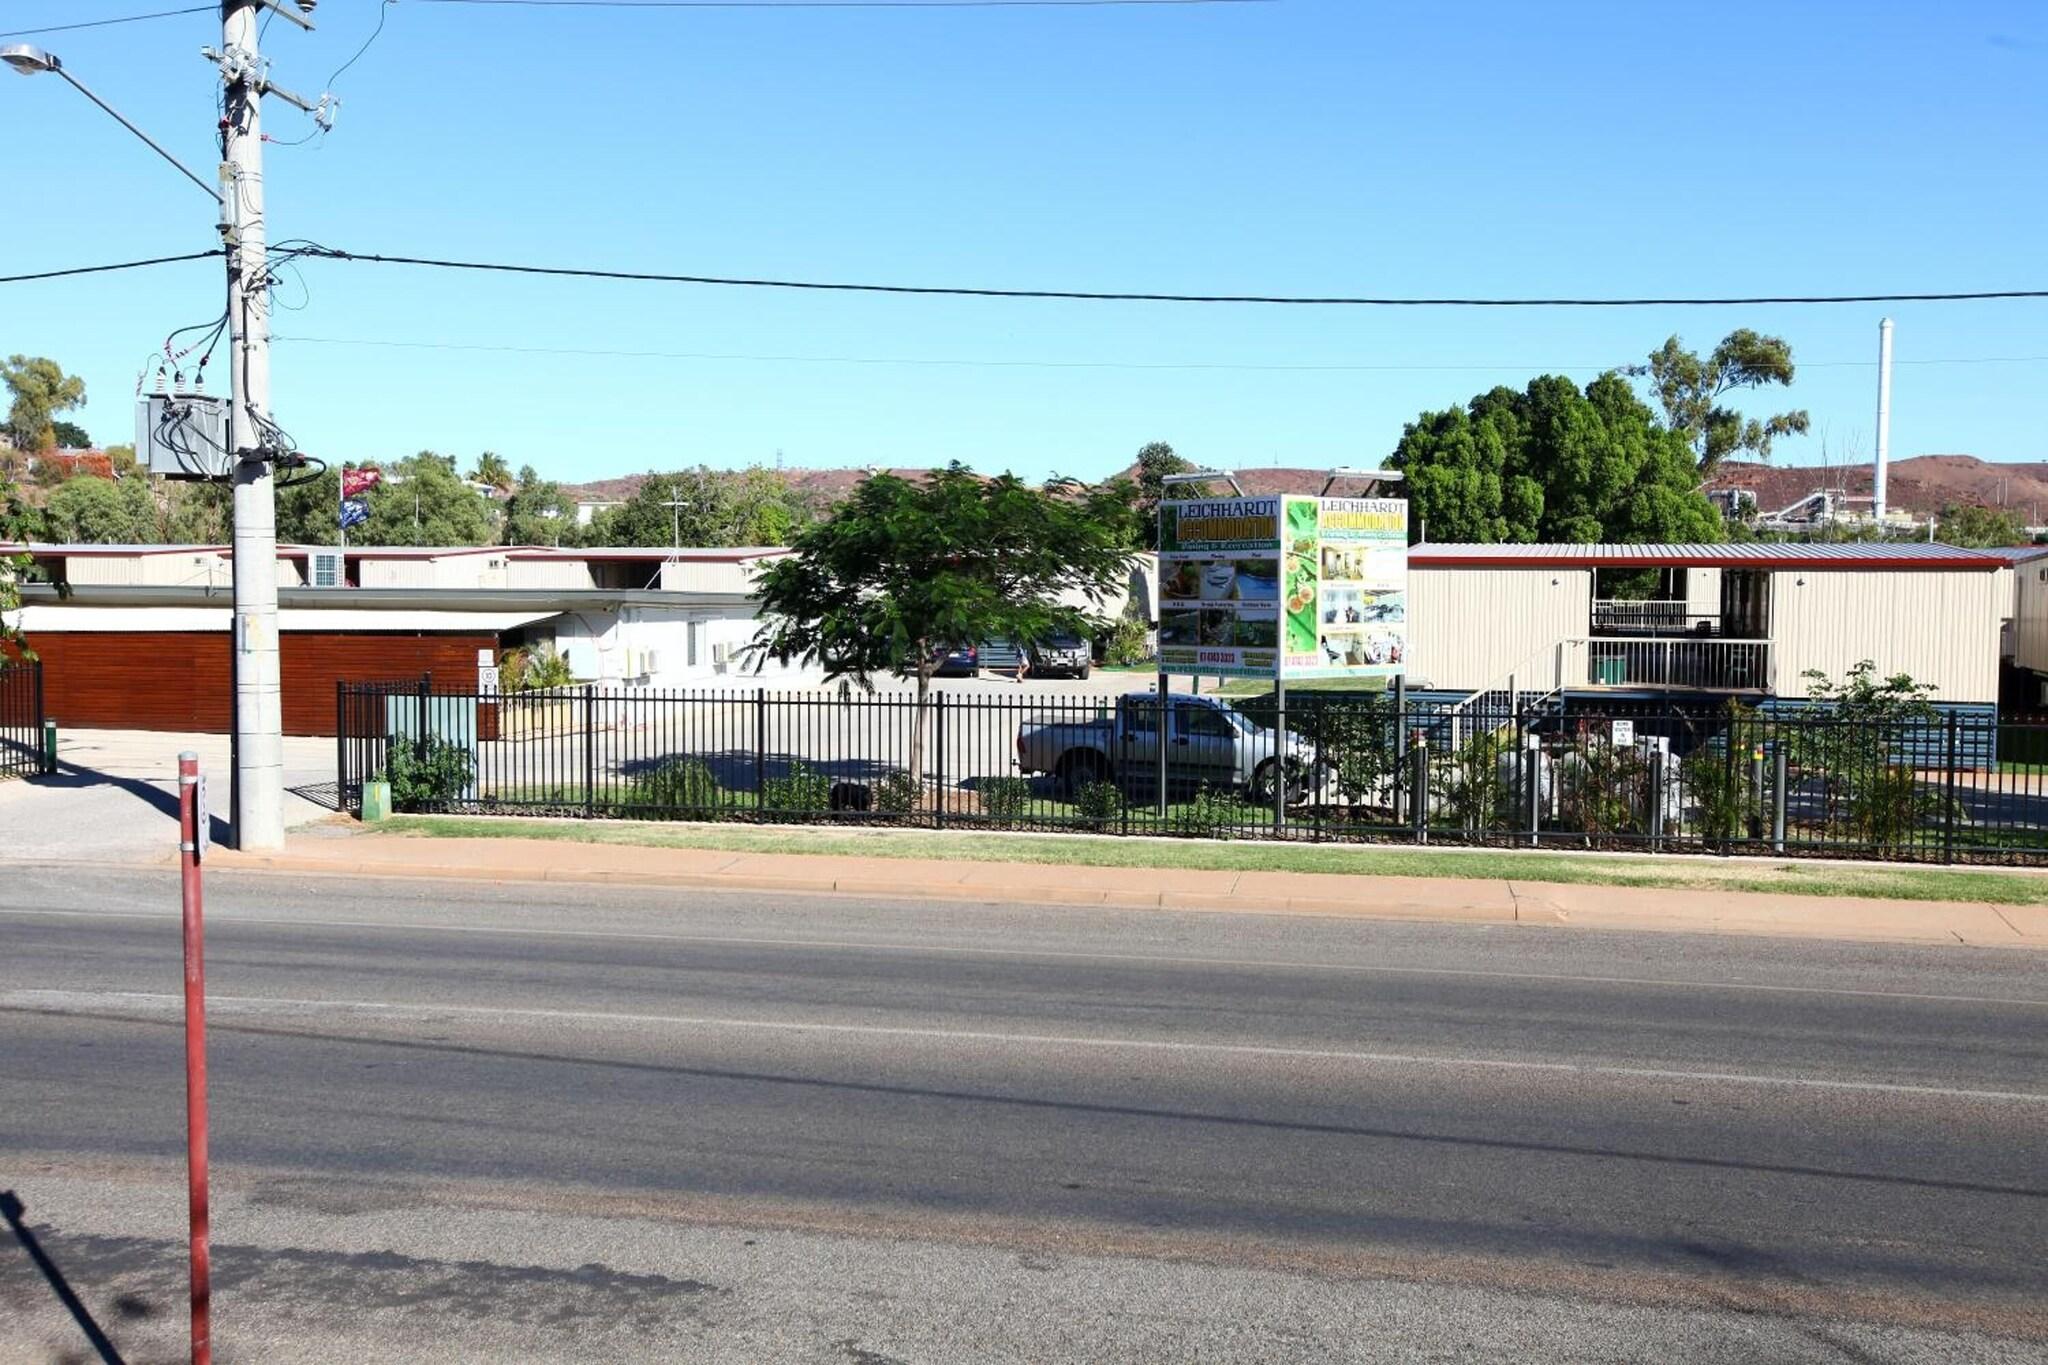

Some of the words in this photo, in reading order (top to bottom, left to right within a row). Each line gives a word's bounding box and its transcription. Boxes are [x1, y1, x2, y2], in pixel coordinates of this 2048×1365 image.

[1178, 500, 1277, 518] LEICHHARDT
[1321, 500, 1405, 513] LEICHHARDT
[1177, 515, 1277, 541] ACCOMMODATION
